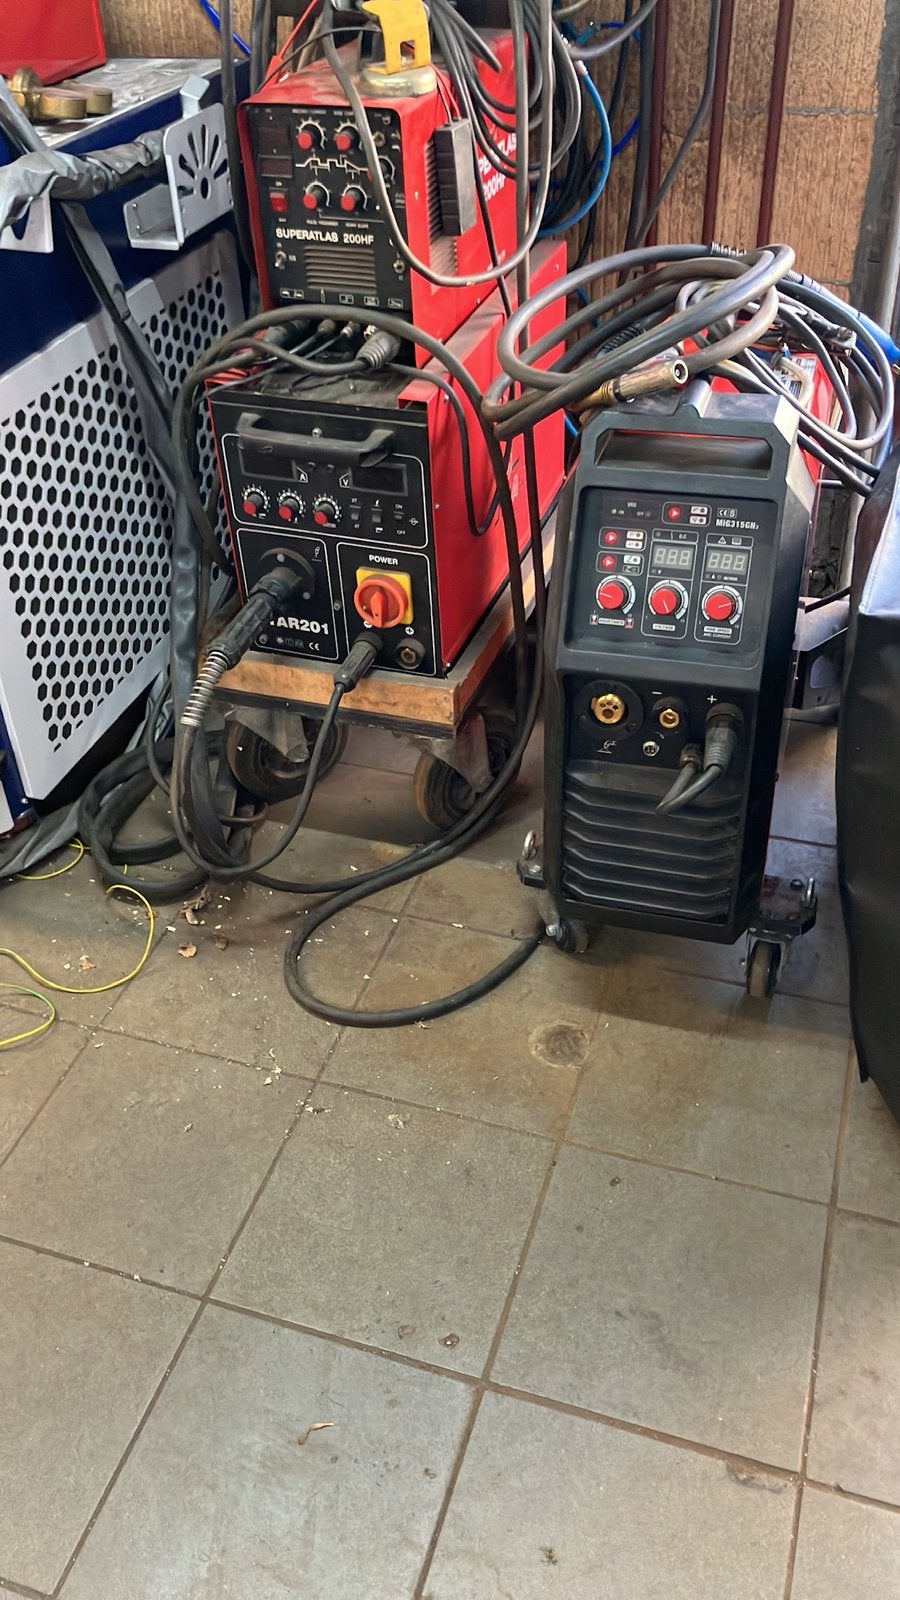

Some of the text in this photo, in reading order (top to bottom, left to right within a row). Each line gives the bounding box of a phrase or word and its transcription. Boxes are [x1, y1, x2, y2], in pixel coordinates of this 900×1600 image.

[276, 228, 374, 244] SUPERATLAS 200HF
[300, 473, 306, 481] A
[368, 554, 398, 565] POWER
[270, 616, 329, 635] AR201
